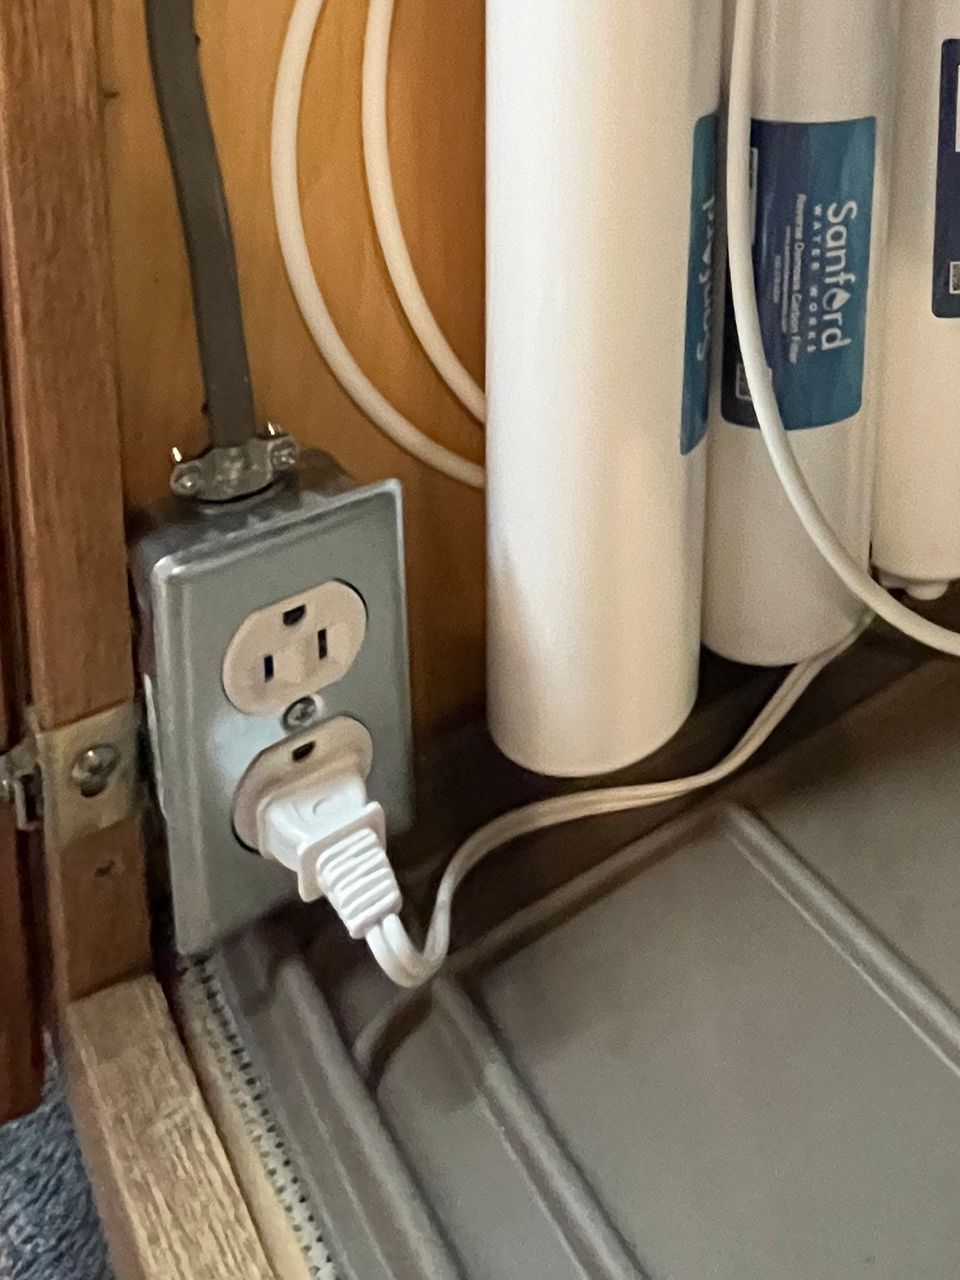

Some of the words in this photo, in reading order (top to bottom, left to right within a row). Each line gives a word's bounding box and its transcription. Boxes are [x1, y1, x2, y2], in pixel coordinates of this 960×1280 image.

[811, 203, 823, 270] WATER
[821, 200, 858, 351] Sanford
[807, 284, 819, 353] WORKS
